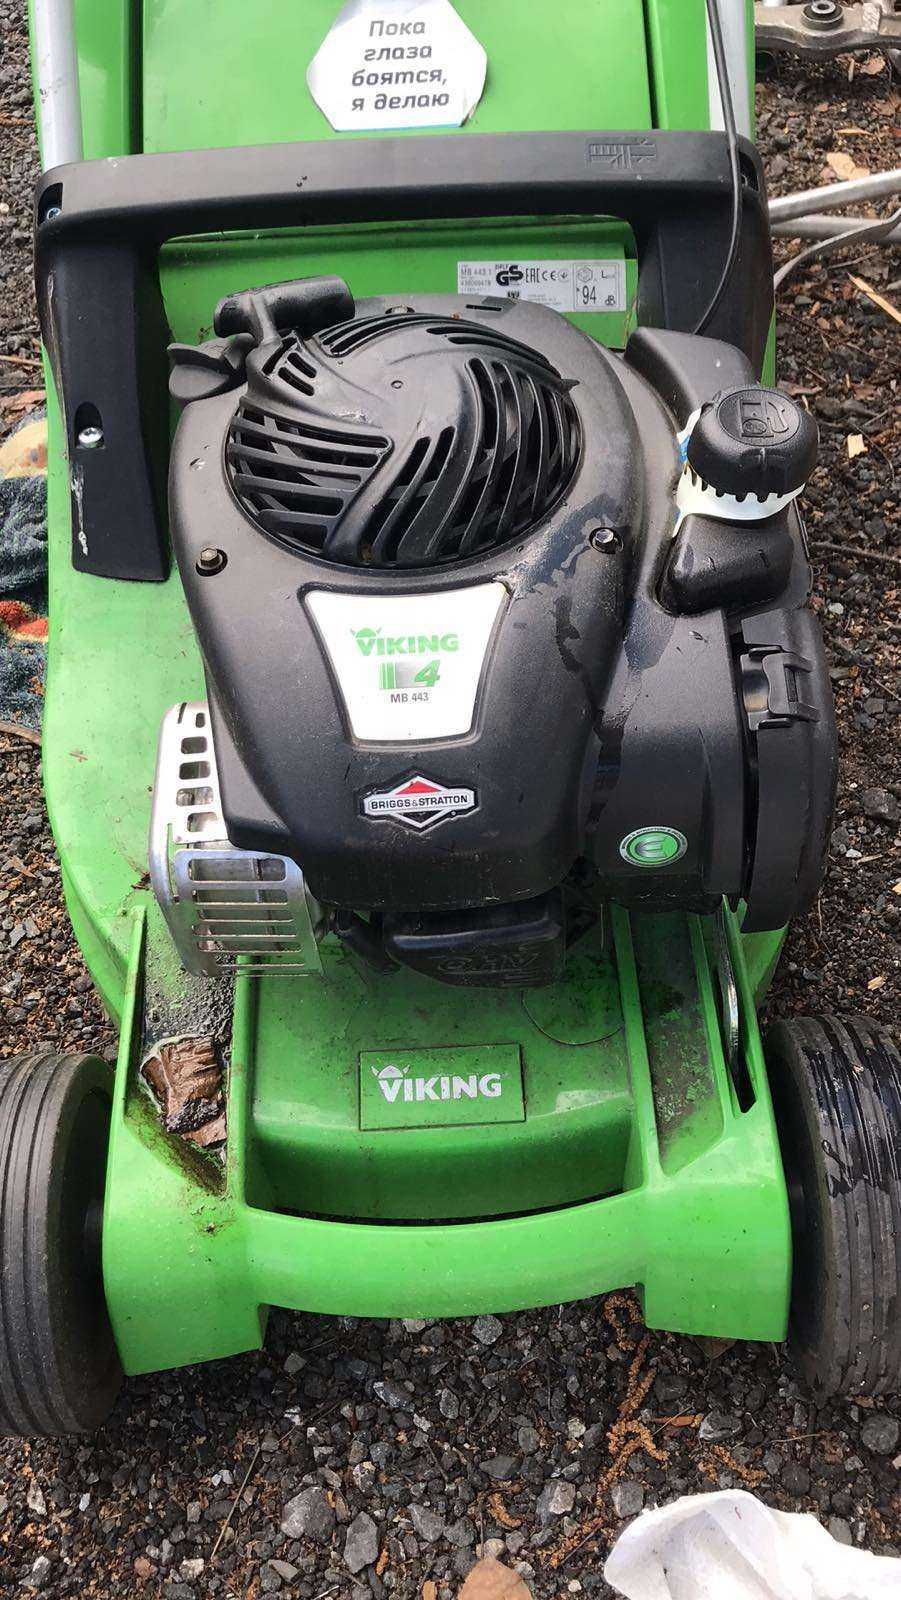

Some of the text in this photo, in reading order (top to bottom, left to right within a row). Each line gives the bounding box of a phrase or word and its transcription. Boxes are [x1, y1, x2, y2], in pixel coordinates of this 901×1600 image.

[369, 20, 425, 36] Пока
[364, 45, 432, 61] глаза
[352, 69, 447, 86] боятся,
[352, 93, 450, 111] я делаю
[582, 285, 597, 305] 94
[356, 634, 459, 656] VIKING
[415, 660, 440, 687] 4
[391, 692, 429, 703] MB 443
[378, 1073, 502, 1103] VIKING
